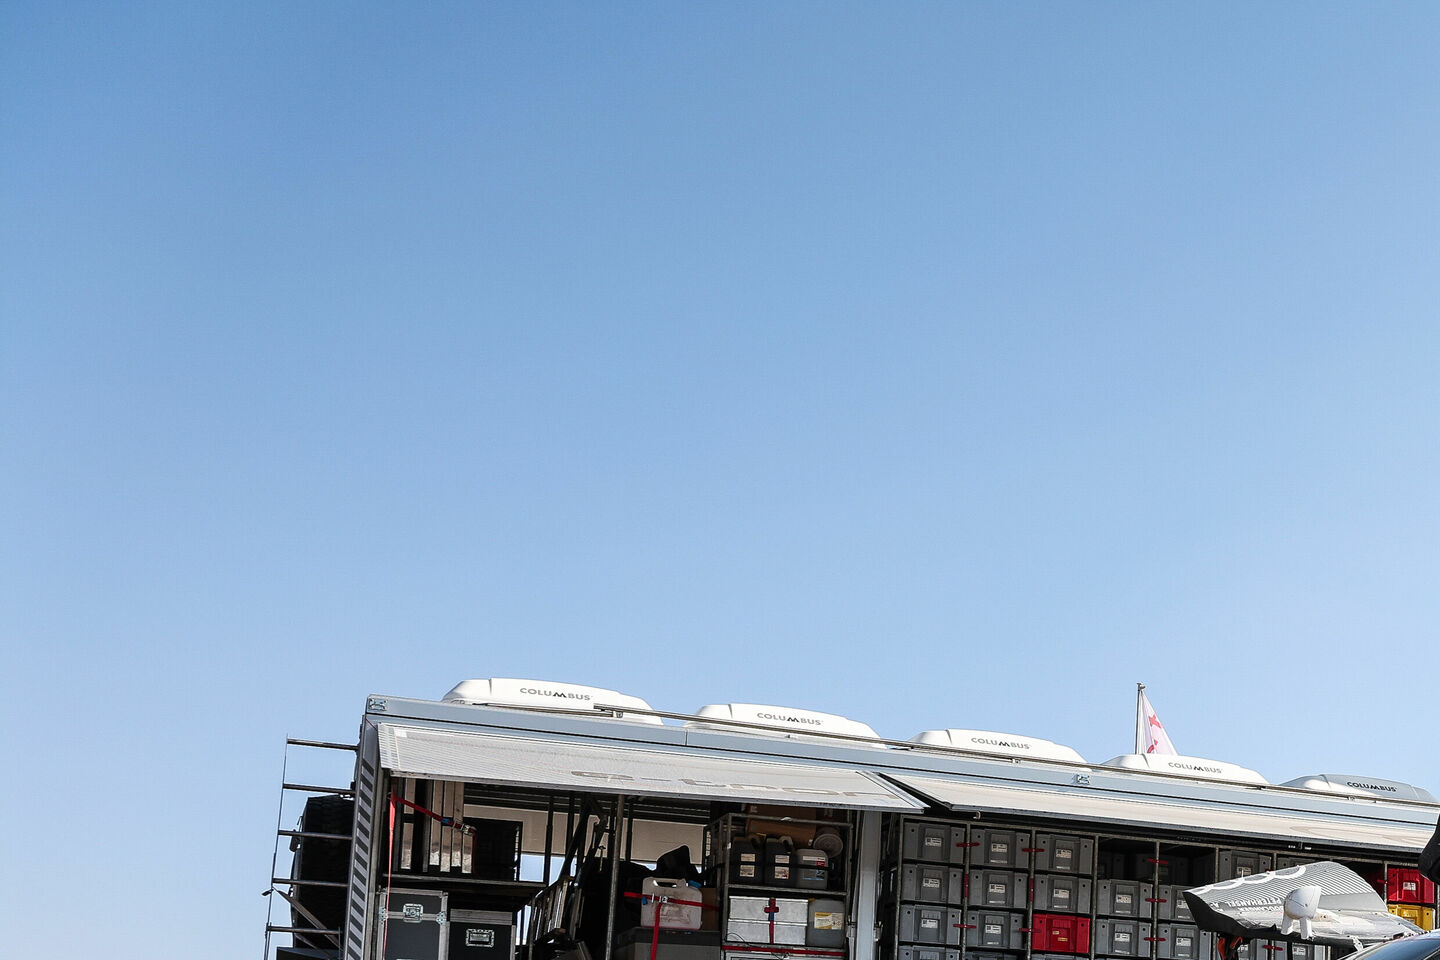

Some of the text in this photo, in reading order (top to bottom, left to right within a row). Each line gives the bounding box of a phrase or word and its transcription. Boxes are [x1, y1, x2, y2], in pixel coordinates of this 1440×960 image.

[520, 687, 591, 701] COLUMBUS
[757, 712, 822, 726] COLUMBUS
[971, 737, 1030, 750] COLUMBUS
[1168, 761, 1221, 774] COLUMBUS
[1346, 781, 1396, 792] COLUMBUS
